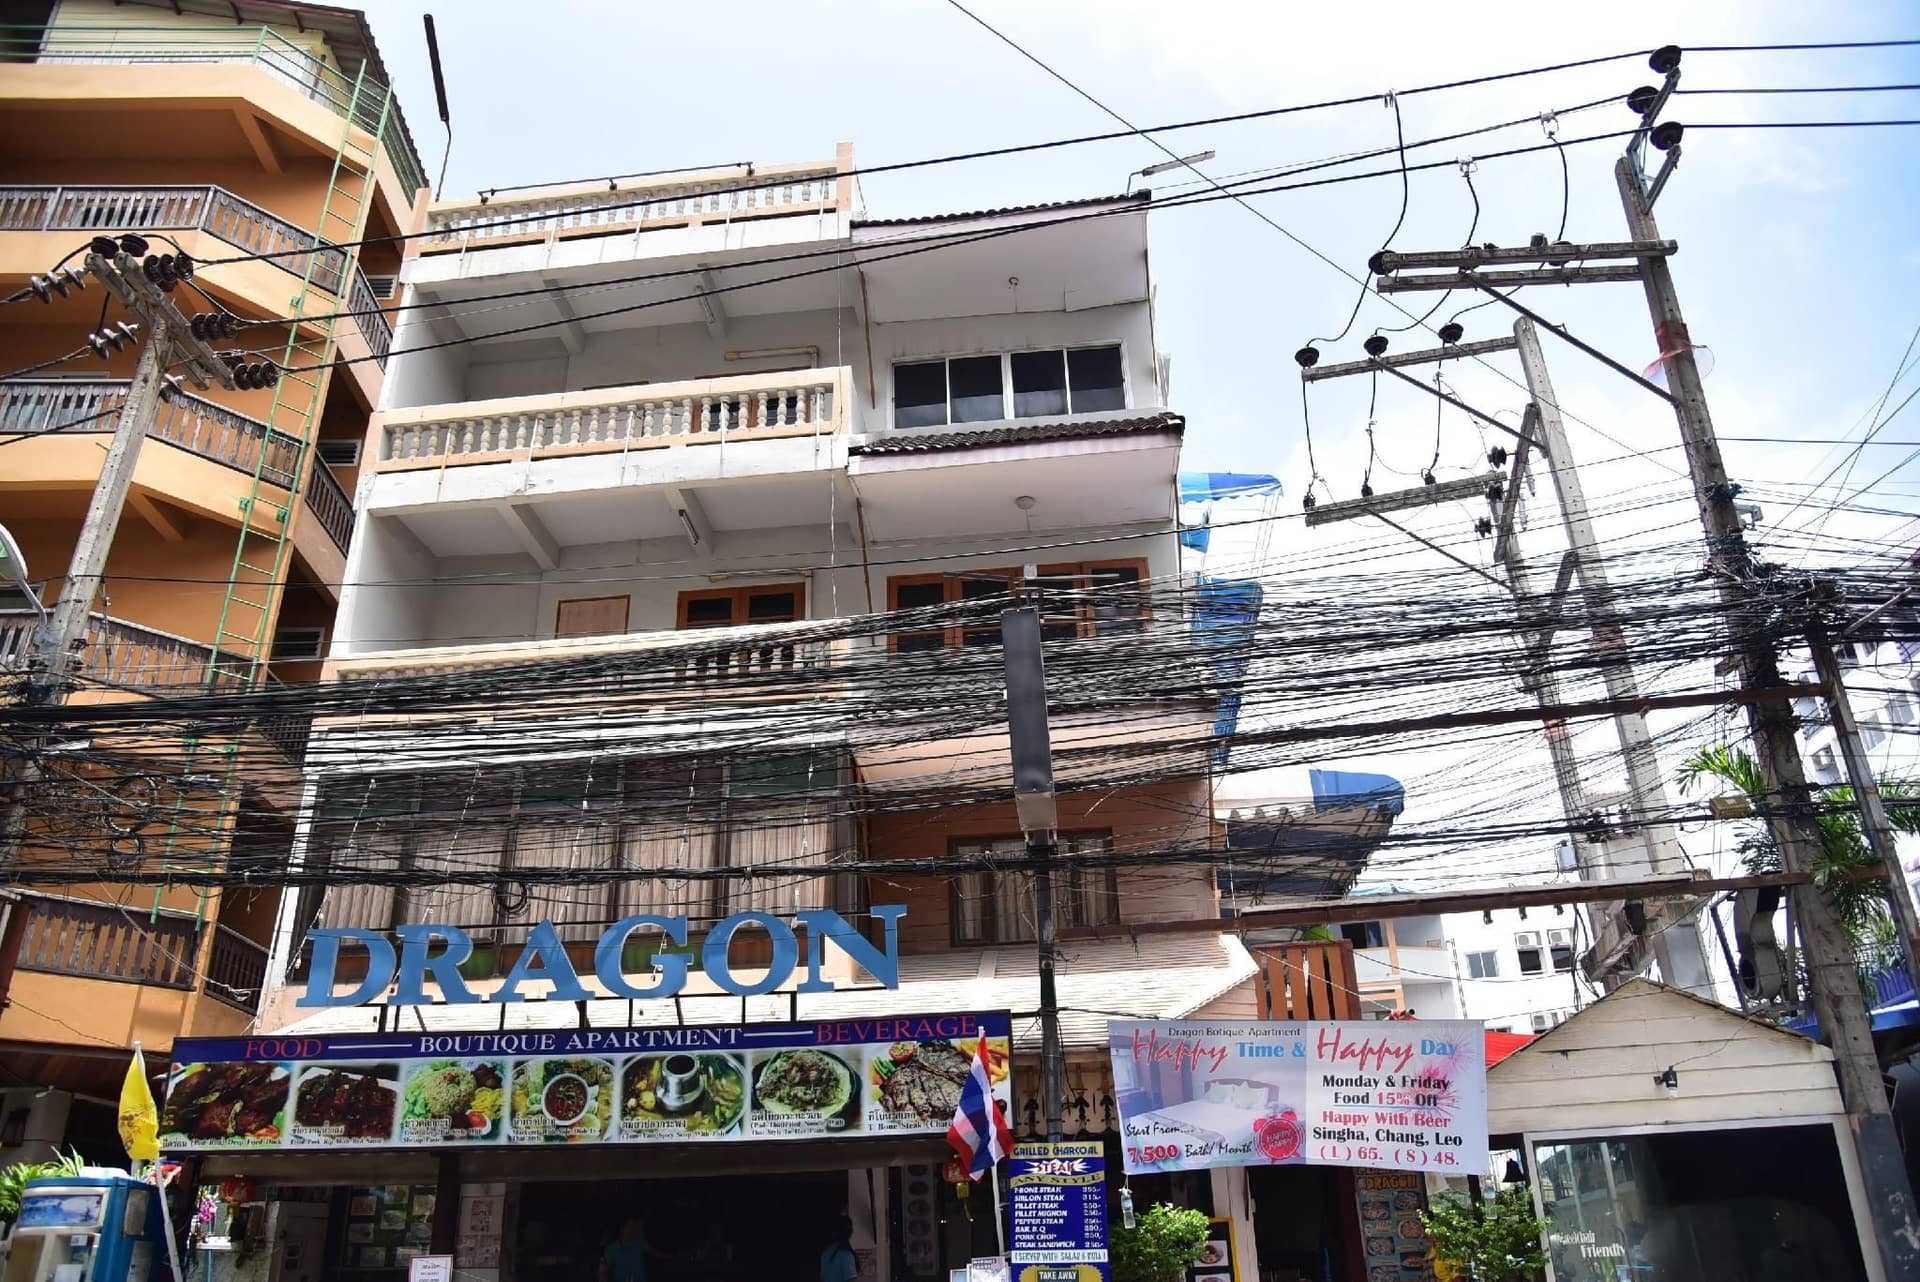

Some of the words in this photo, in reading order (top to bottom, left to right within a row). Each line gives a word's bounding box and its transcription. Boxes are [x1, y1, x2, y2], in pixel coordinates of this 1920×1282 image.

[295, 904, 907, 1007] DRAGON
[245, 1038, 323, 1059] FOOD
[419, 1033, 556, 1054] BOUTIQUE
[565, 1027, 743, 1051] APARTMENT
[816, 1015, 979, 1044] BEVERAGE
[1168, 1027, 1203, 1040] Dragon
[1248, 1027, 1301, 1040] Apartment
[1132, 1028, 1230, 1073] Happy
[1236, 1041, 1284, 1058] Time
[1292, 1041, 1306, 1058] &
[1316, 1027, 1415, 1073] Happy
[1420, 1039, 1458, 1056] Day
[1322, 1075, 1380, 1089] Monday
[1385, 1075, 1396, 1087] &
[1401, 1075, 1451, 1090] Friday
[1334, 1092, 1370, 1104] Food
[1377, 1092, 1411, 1106] 15%
[1415, 1093, 1438, 1107] Off
[1322, 1111, 1370, 1128] Happy
[1375, 1111, 1409, 1126] With
[1413, 1112, 1451, 1128] Beer
[1125, 1123, 1150, 1138] Start
[1313, 1127, 1369, 1143] Singha,
[1375, 1129, 1429, 1146] Chang,
[1435, 1132, 1463, 1146] Leo
[1013, 1146, 1049, 1156] GRILLED
[1052, 1146, 1099, 1155] CHARCOAL
[1127, 1144, 1179, 1164] 7,500
[1218, 1141, 1253, 1155] Month
[1358, 1147, 1384, 1161] 65.
[1433, 1151, 1460, 1166] 48.
[1037, 1162, 1075, 1172] STEAK
[1015, 1175, 1045, 1184] ANY
[1050, 1173, 1101, 1184] STYLE
[1039, 1271, 1057, 1281] TAKE
[1058, 1271, 1077, 1280] AWAY
